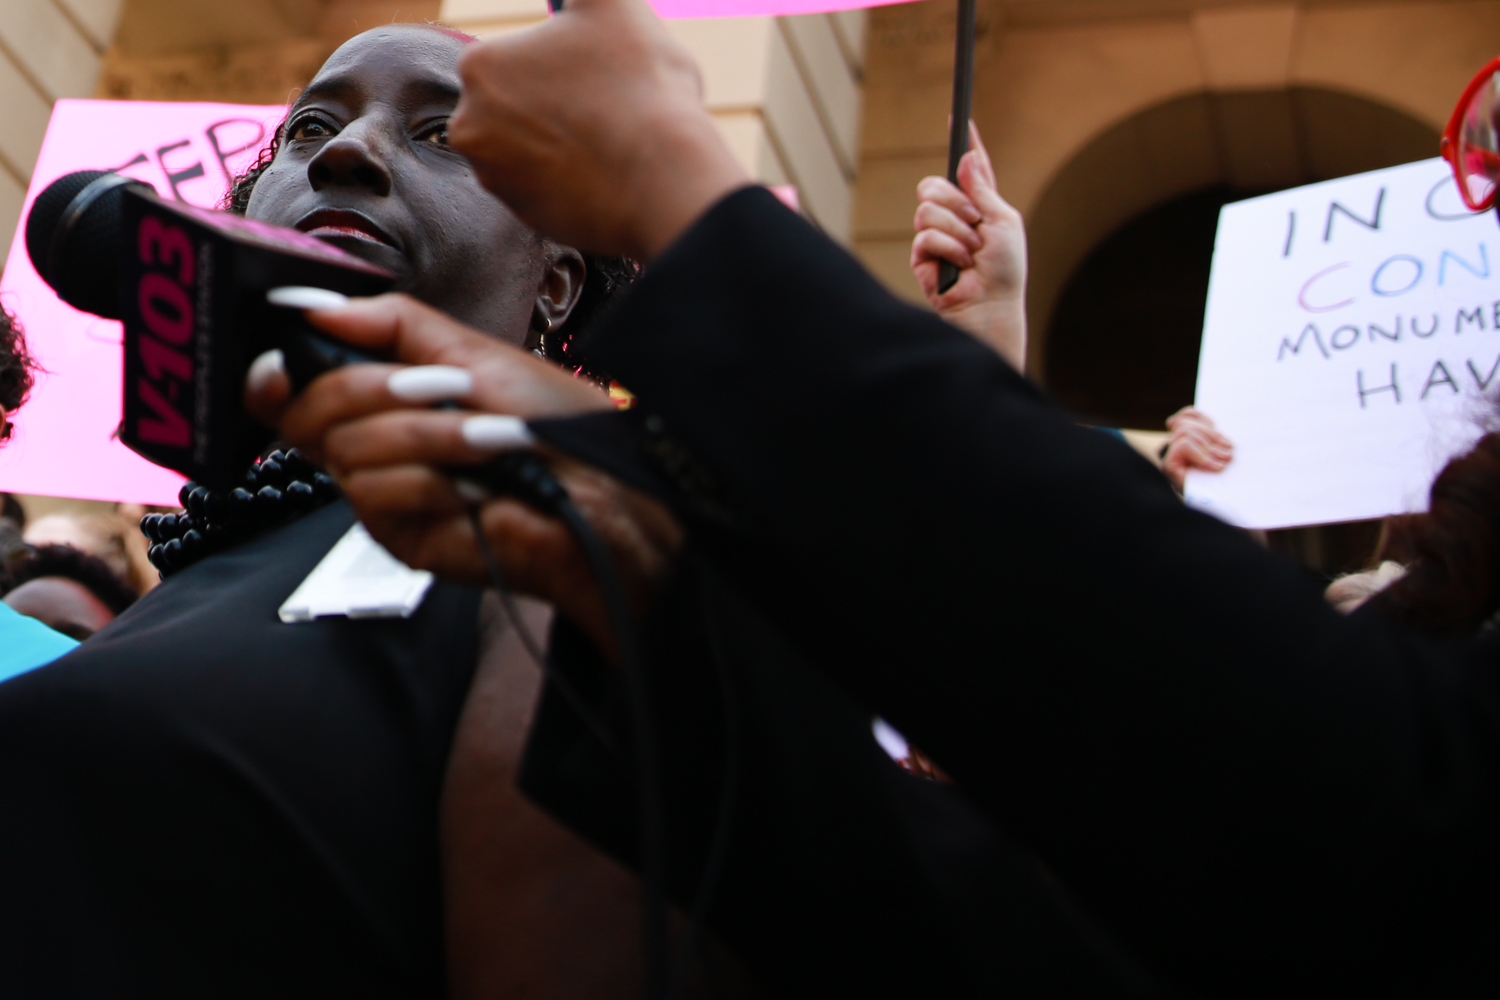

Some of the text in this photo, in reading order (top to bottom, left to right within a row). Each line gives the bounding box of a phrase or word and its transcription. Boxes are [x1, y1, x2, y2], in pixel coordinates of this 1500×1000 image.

[106, 119, 264, 208] EP
[1283, 186, 1388, 258] IN
[1298, 241, 1490, 313] CON
[137, 214, 195, 449] V-103
